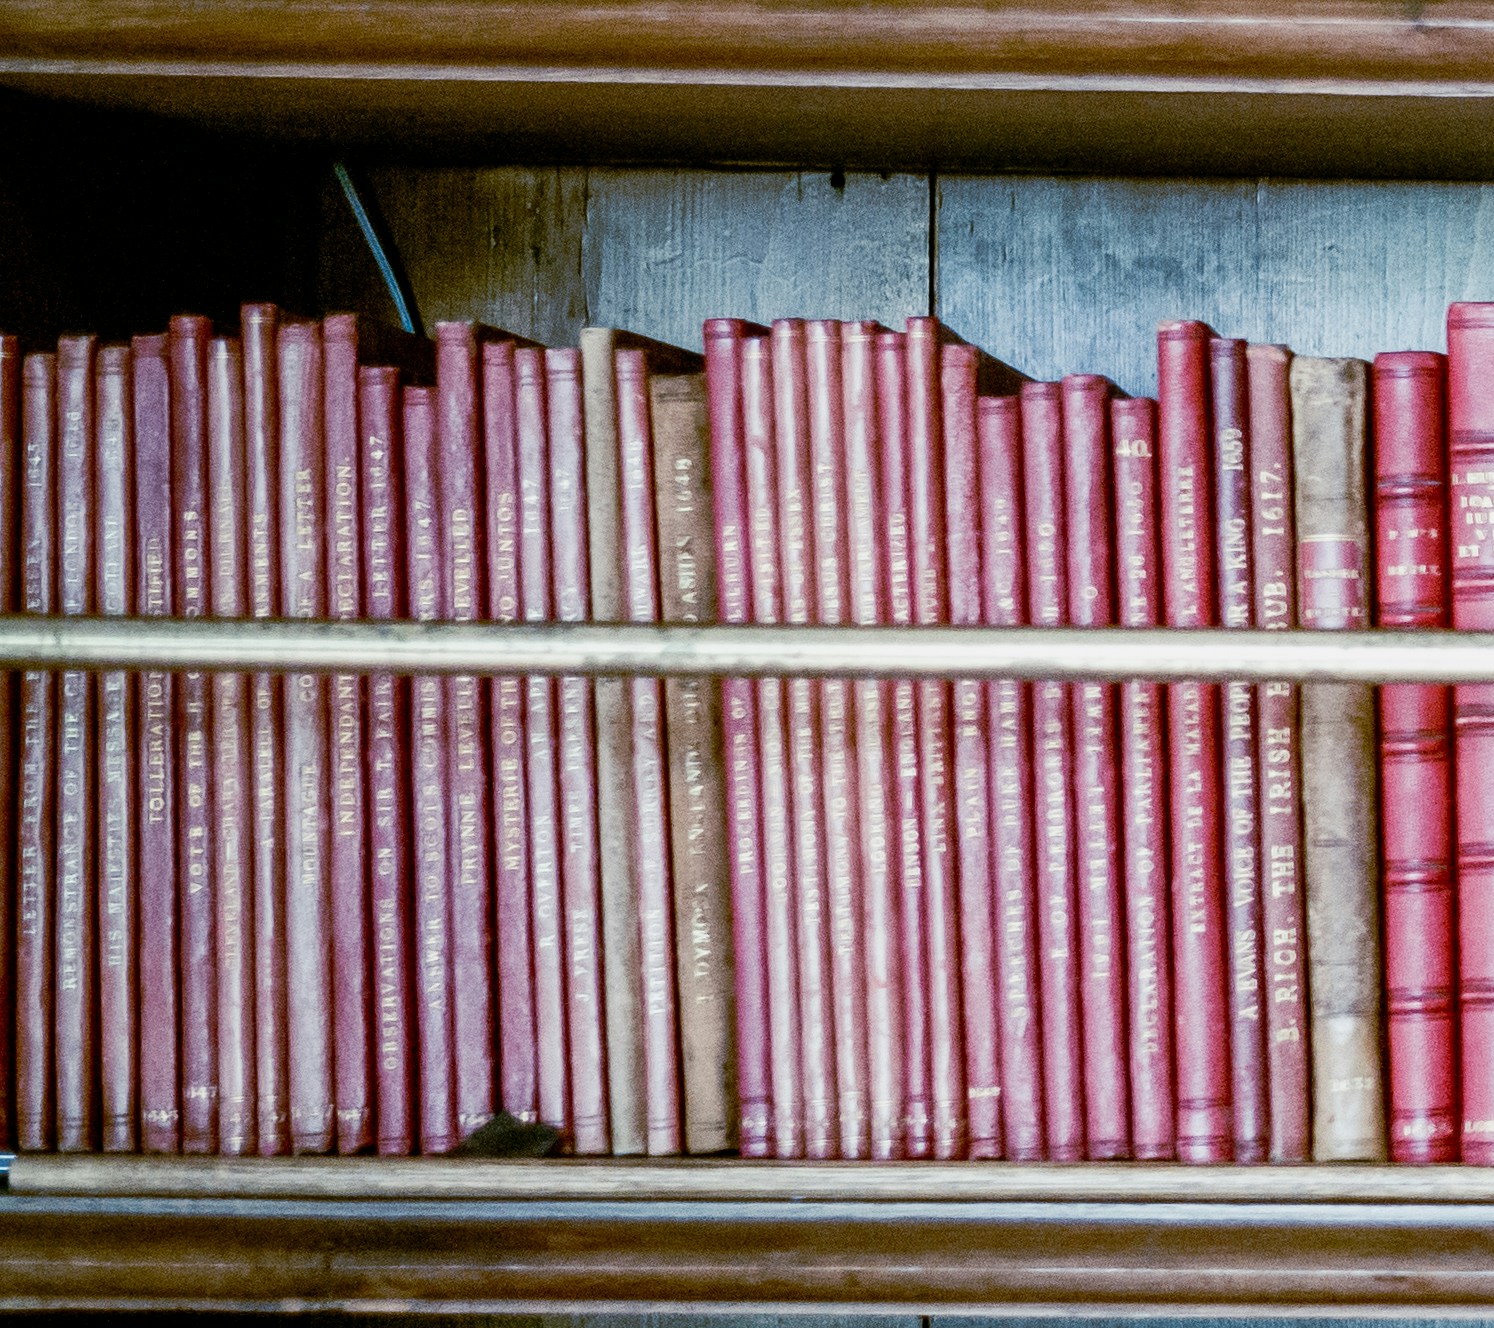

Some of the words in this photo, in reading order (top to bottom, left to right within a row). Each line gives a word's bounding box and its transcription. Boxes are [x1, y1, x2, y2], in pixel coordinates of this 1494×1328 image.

[1228, 582, 1247, 596] A
[1230, 756, 1253, 797] THE
[1268, 726, 1292, 814] IRISH
[1230, 809, 1254, 833] OF
[1232, 841, 1256, 906] VOICE
[1271, 844, 1296, 898] THE
